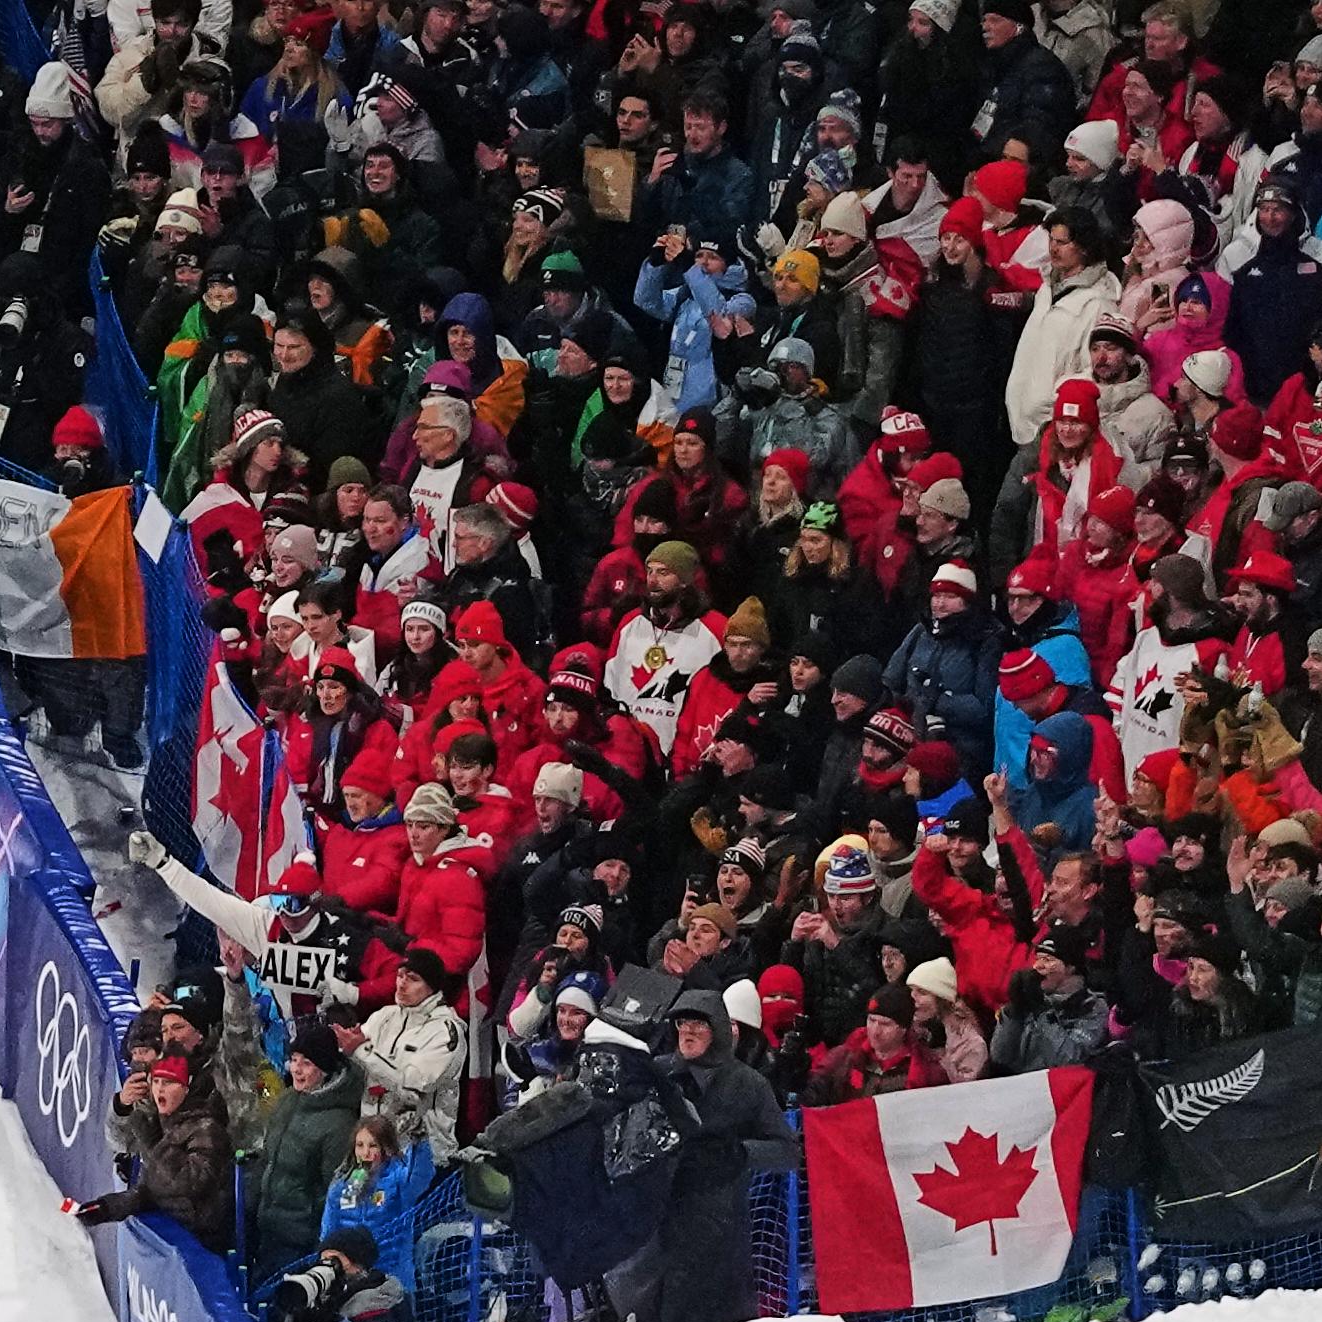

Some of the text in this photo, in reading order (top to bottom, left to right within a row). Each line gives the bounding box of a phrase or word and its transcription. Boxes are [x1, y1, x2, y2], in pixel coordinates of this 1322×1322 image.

[512, 198, 544, 223] SA
[405, 604, 443, 623] ANADA
[551, 673, 593, 694] NADA
[629, 704, 676, 718] ANAD
[564, 911, 588, 929] USA
[260, 947, 330, 990] ALEX
